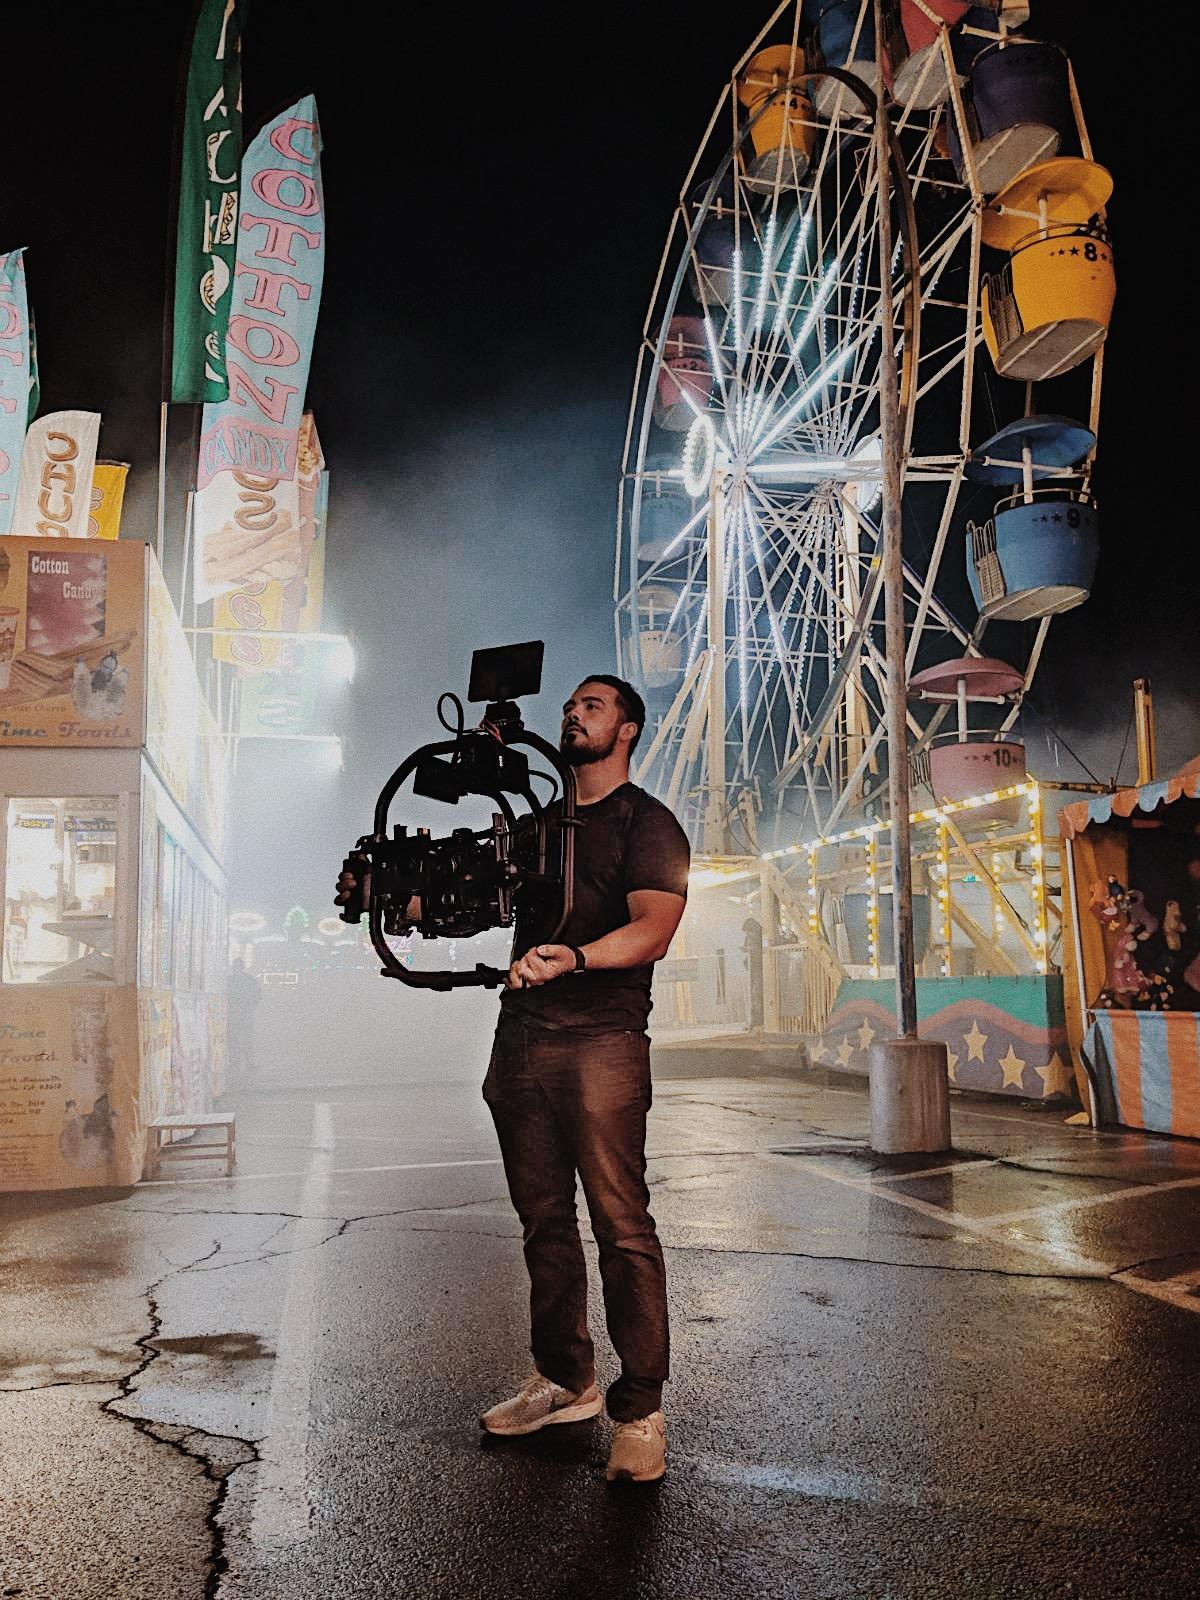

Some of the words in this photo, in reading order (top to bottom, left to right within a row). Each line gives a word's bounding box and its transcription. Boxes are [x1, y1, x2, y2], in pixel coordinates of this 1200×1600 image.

[1084, 242, 1098, 262] 8
[226, 118, 322, 424] COTTON
[205, 426, 292, 476] CANDY
[1066, 507, 1081, 529] 9
[31, 555, 69, 575] Cotton
[58, 720, 132, 738] Foods
[992, 748, 1011, 767] 10
